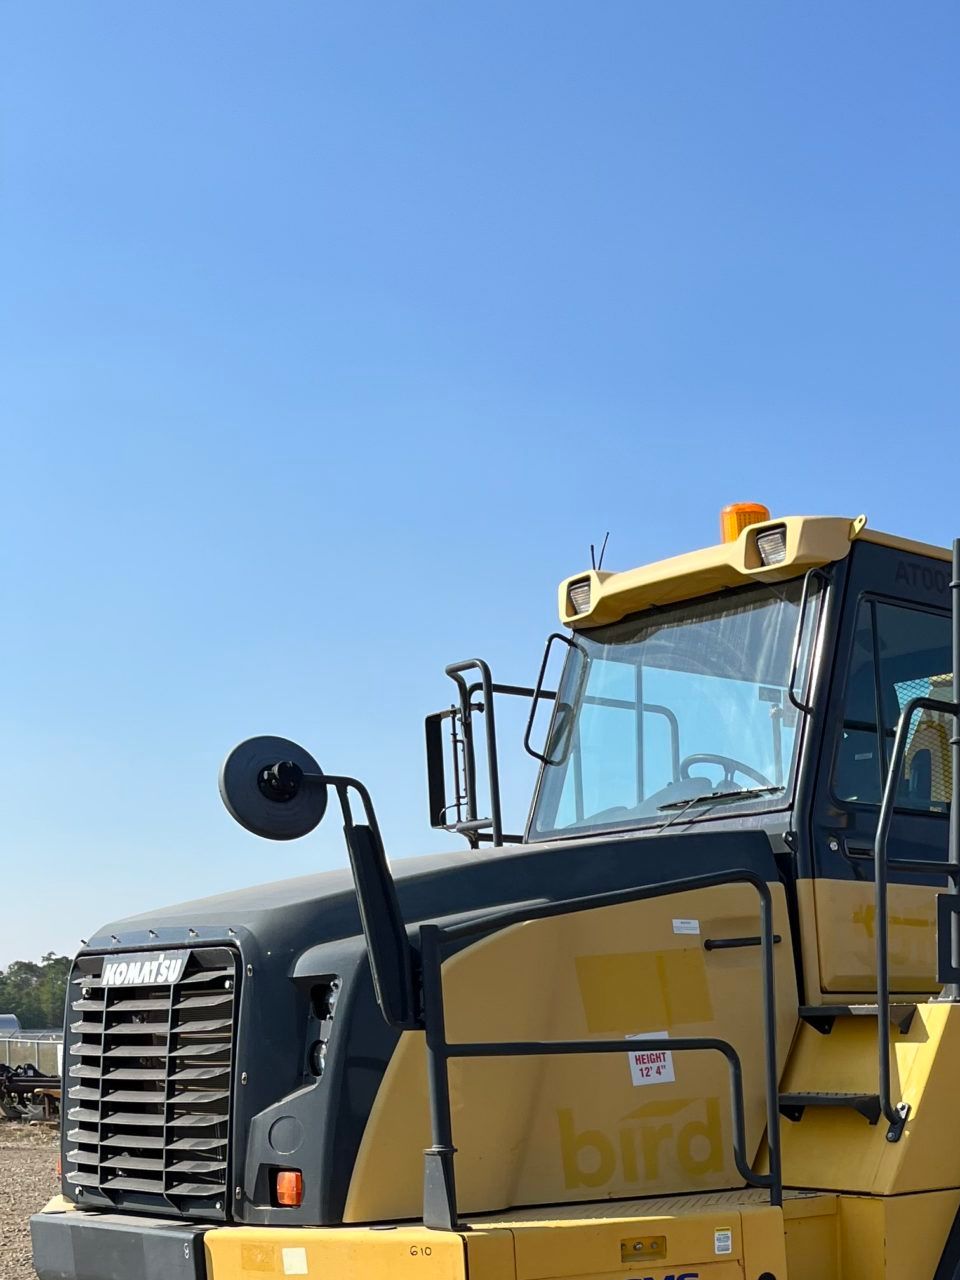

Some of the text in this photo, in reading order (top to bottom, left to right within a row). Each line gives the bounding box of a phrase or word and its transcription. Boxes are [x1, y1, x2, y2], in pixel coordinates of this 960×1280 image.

[102, 954, 183, 985] KOMATSU
[634, 1052, 667, 1065] HEIGHT
[639, 1064, 666, 1078] 12' 4"
[556, 1096, 724, 1190] bird
